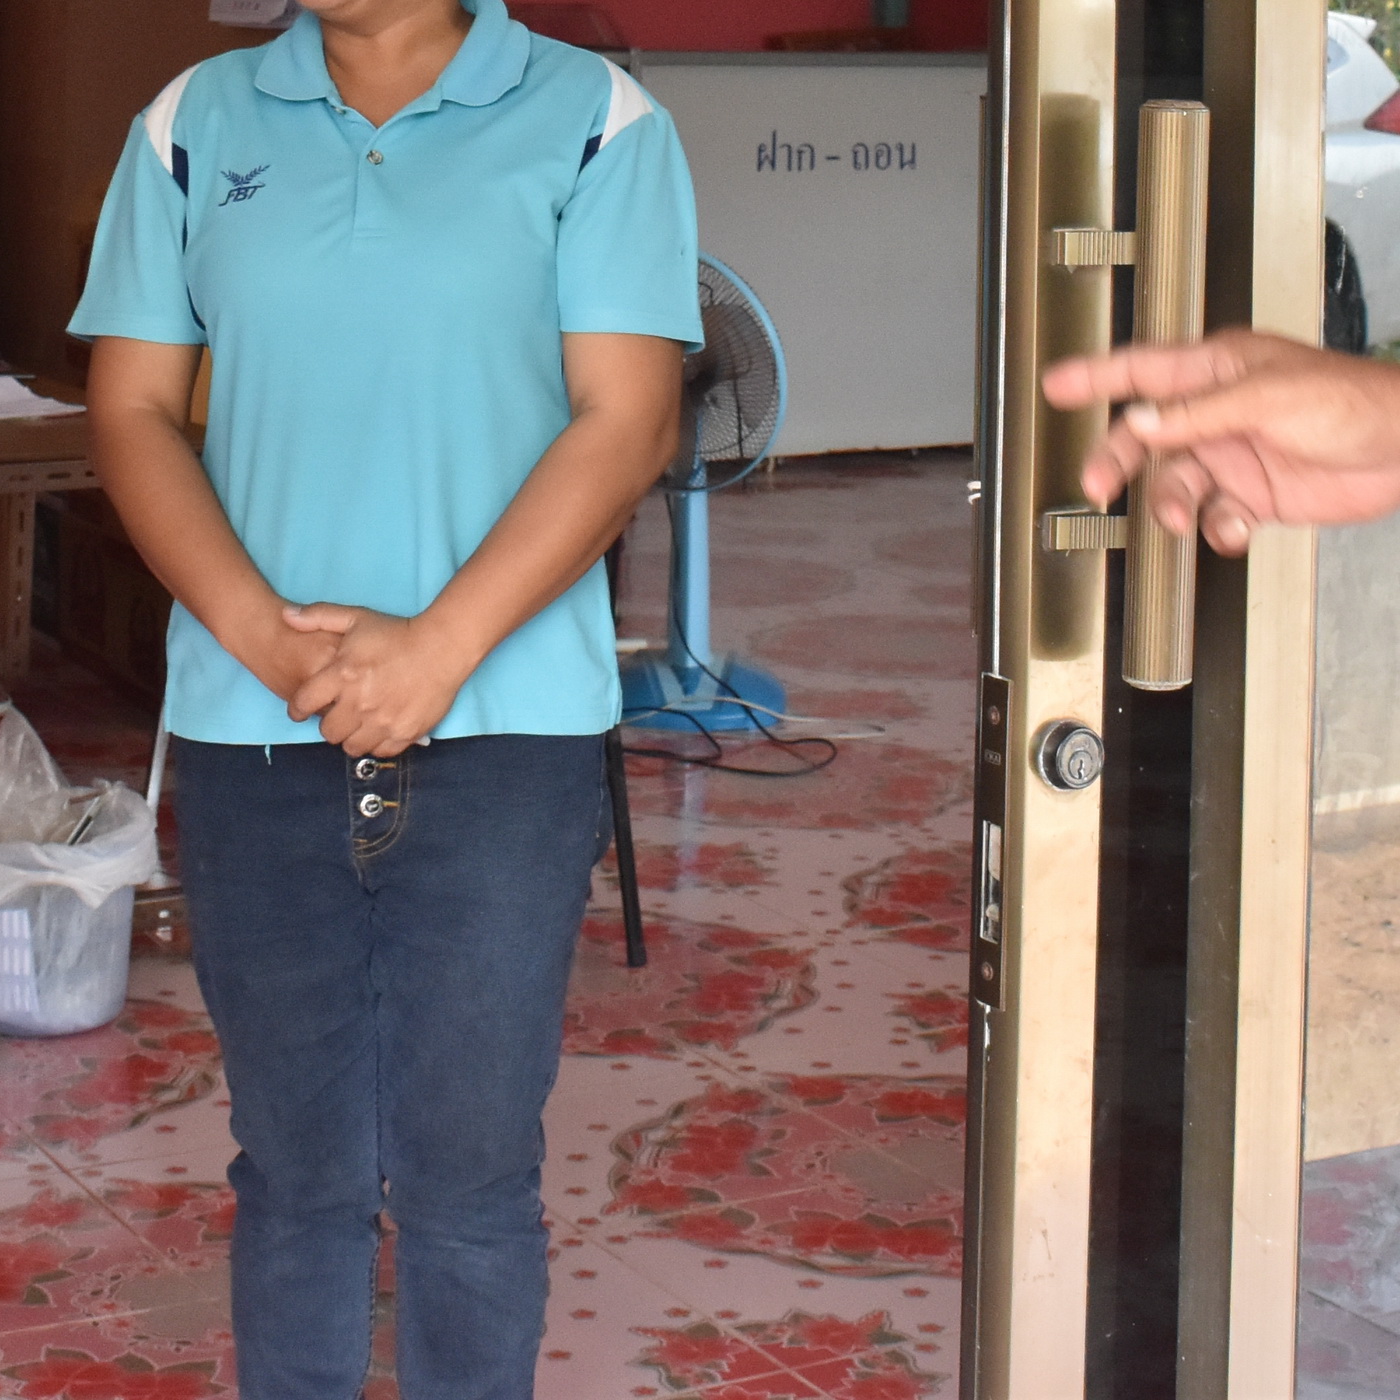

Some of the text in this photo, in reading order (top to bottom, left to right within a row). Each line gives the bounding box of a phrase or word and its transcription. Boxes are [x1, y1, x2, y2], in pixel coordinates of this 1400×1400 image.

[755, 129, 817, 172] ฝาก
[851, 140, 917, 172] ถอน
[218, 182, 266, 207] FBT
